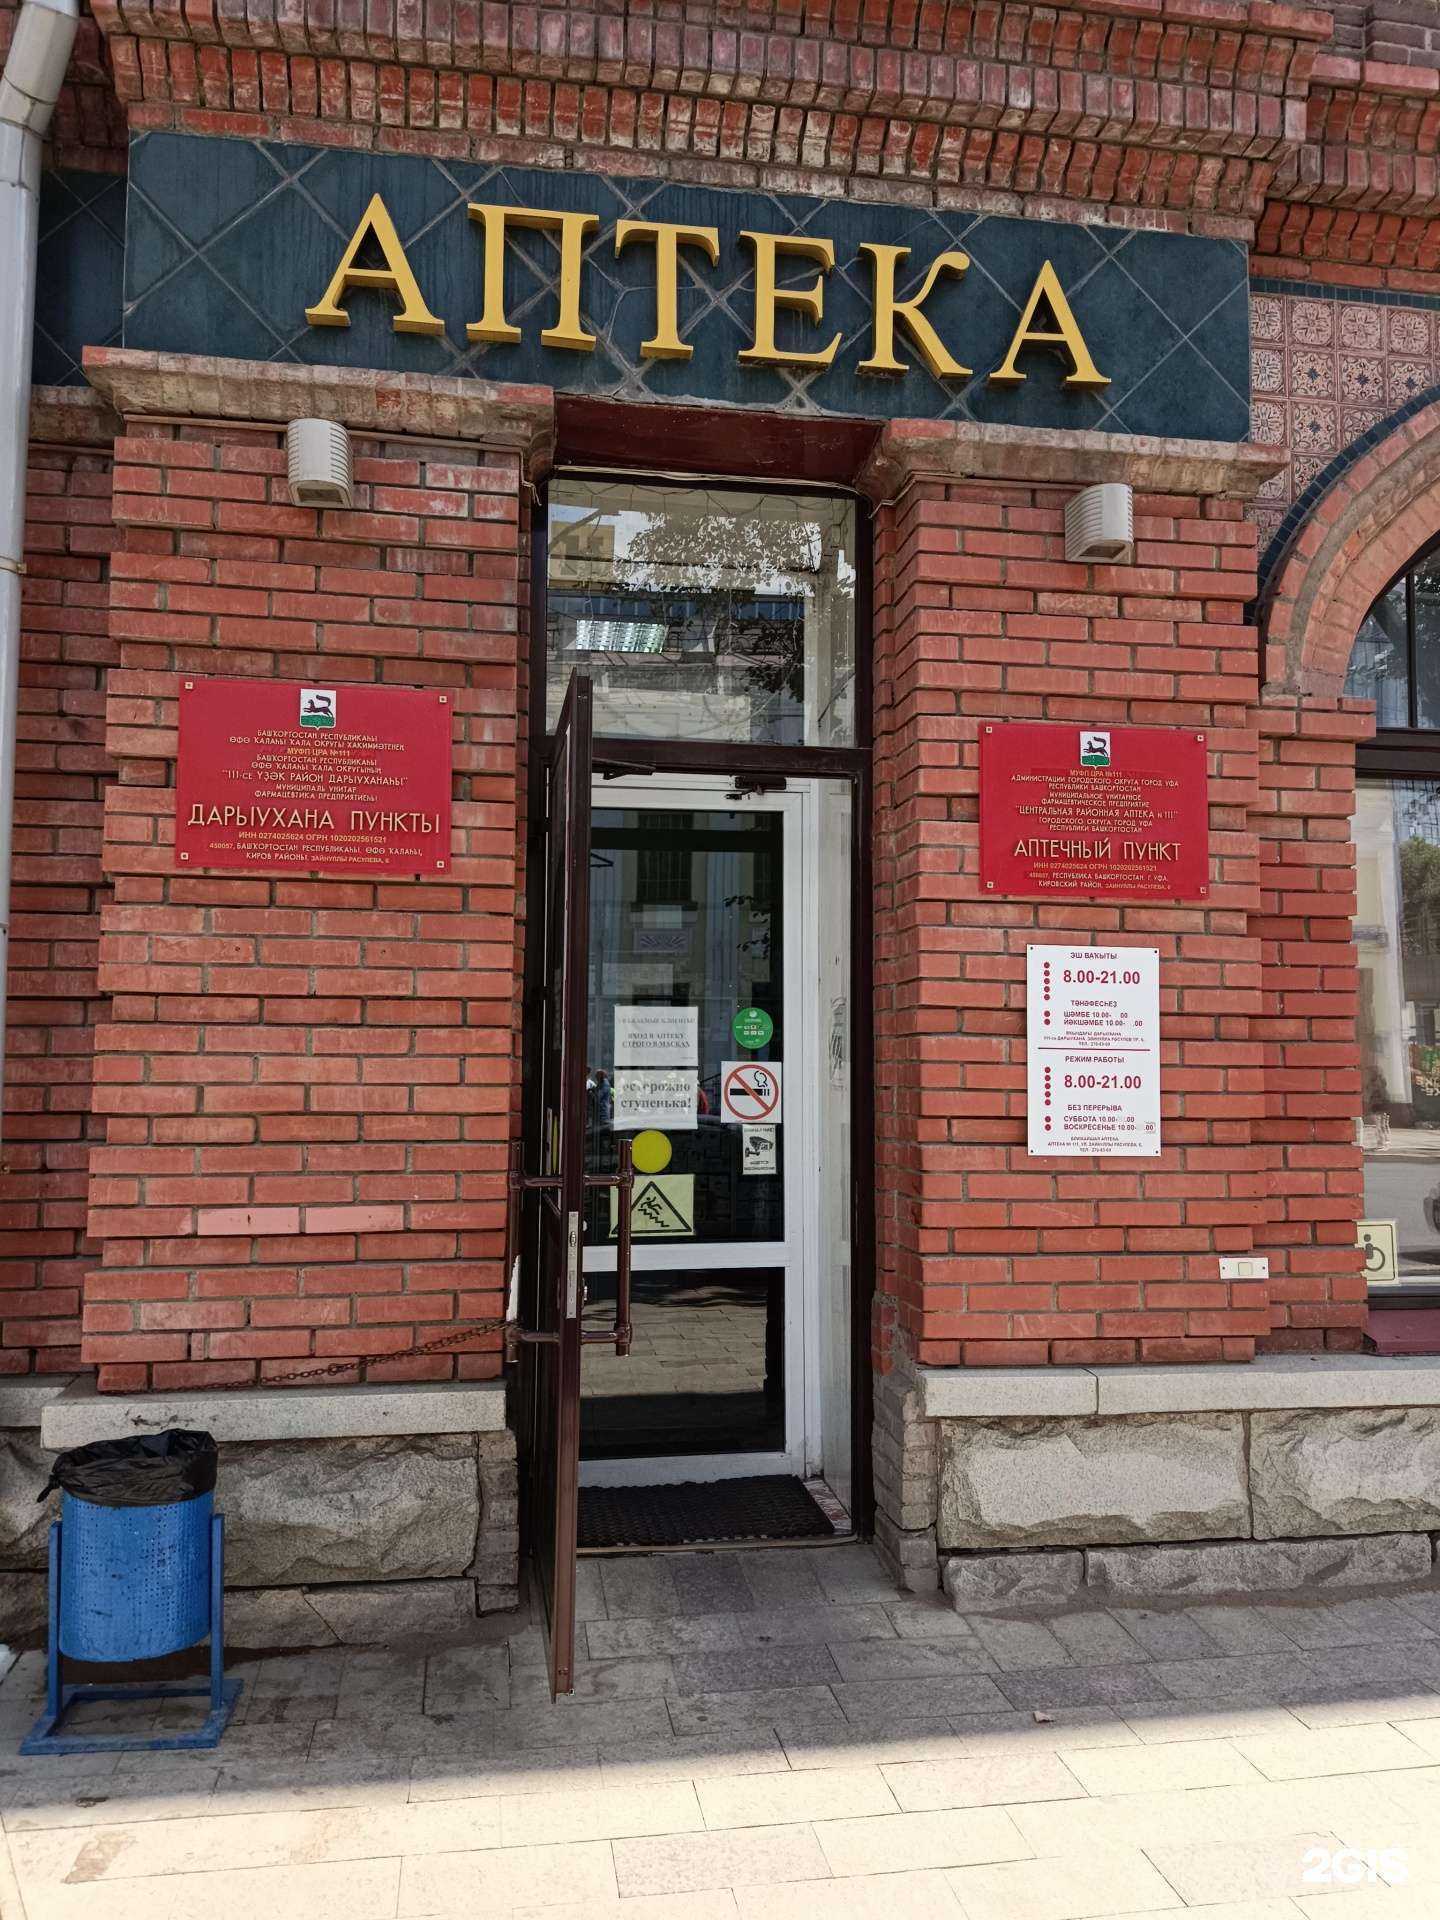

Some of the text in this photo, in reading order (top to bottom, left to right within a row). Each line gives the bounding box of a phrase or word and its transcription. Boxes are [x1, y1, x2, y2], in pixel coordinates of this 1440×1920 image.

[305, 192, 1112, 388] АПТЕКА
[290, 770, 324, 783] РАЙОН
[1067, 776, 1111, 785] ГОРОДСКОГО
[1114, 777, 1139, 786] ОКРУГА
[1141, 779, 1163, 787] ГОРОД
[1048, 783, 1089, 791] РЕСПУБЛИКИ
[188, 803, 440, 834] ДАРЫУХАНА ПУНКТЫ
[1075, 807, 1120, 818] РАЙОННАЯ
[1124, 809, 1155, 819] АПТЕКА
[1039, 816, 1153, 828] ГОРОДСКОГО ОКРУГА ГОРОД УФА
[1049, 824, 1089, 832] РЕСПУБЛИКИ
[1014, 837, 1182, 862] АПТЕЧНЫЙ ПУНКТ
[1063, 969, 1141, 985] 8.00-21.00
[1064, 1056, 1125, 1064] РЕЖИМ РАБОТЫ
[1064, 1074, 1142, 1090] 8.00-21.00
[621, 1098, 691, 1111] ступенька!
[1083, 1104, 1123, 1112] ПЕРЕРЫВА
[1063, 1123, 1116, 1131] ВОСКРЕСЕНЬЕ
